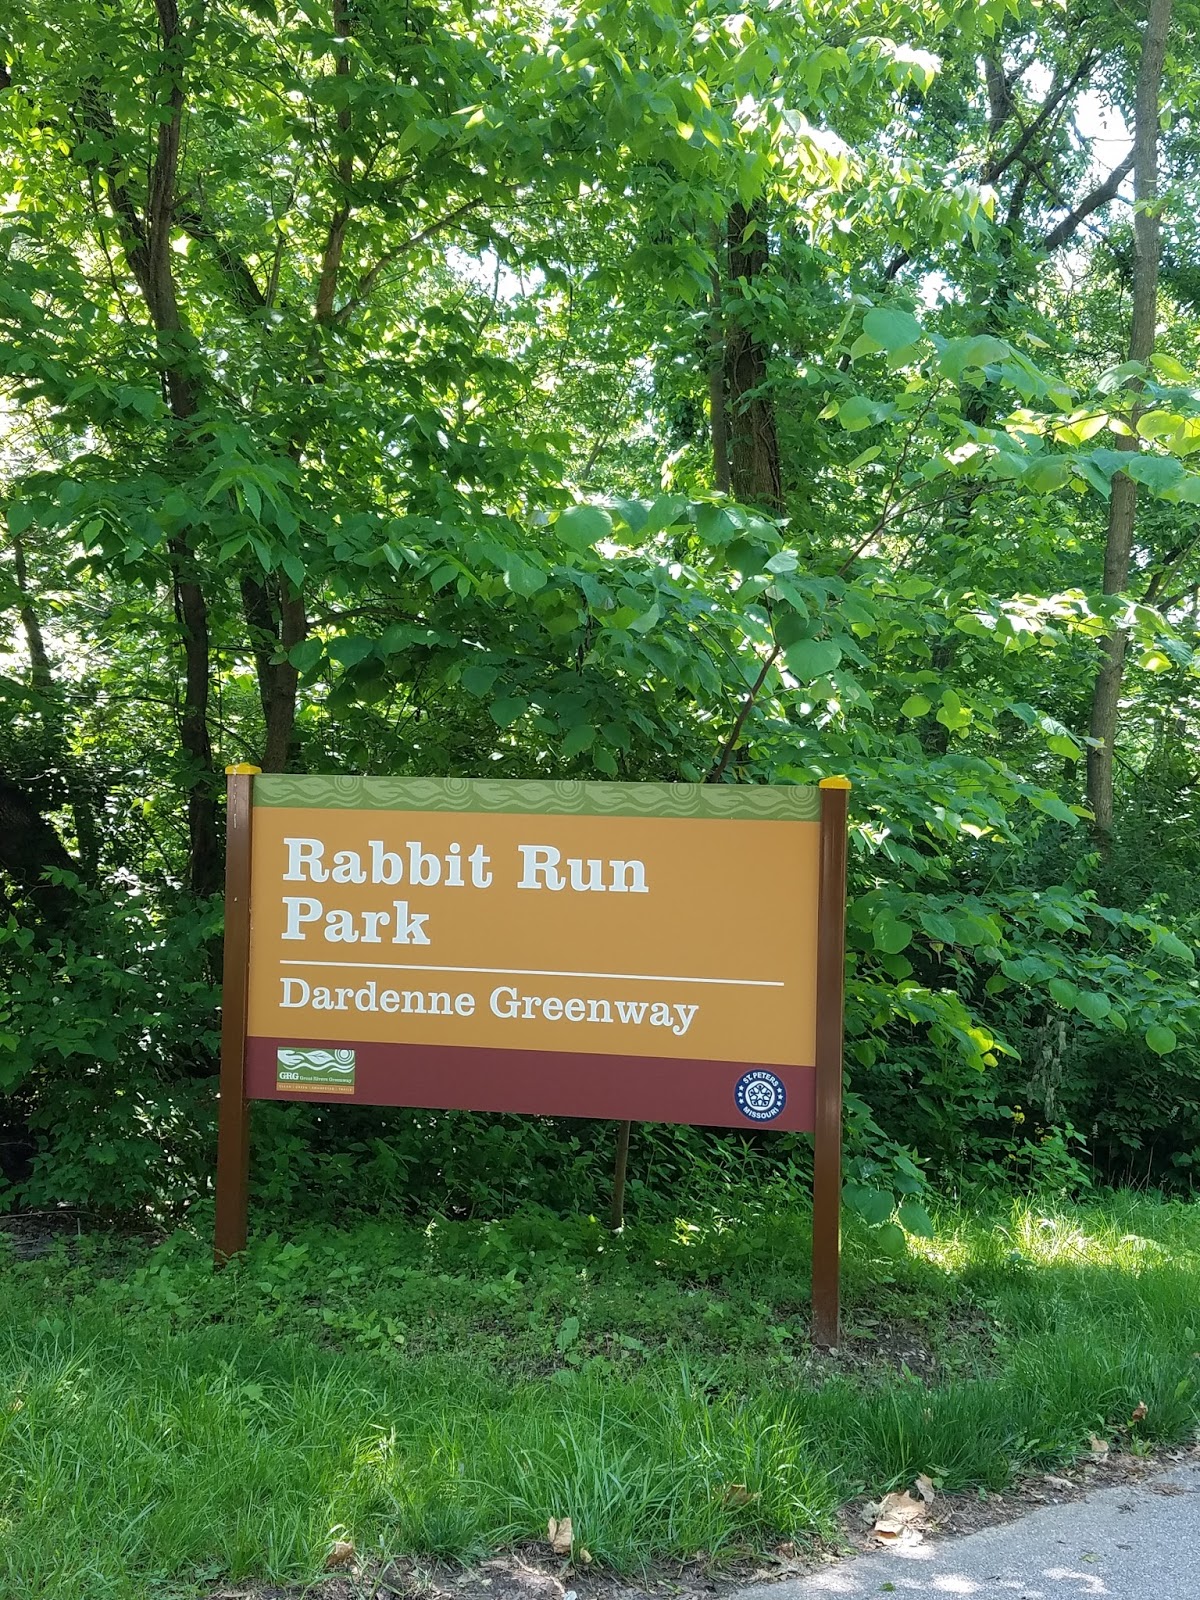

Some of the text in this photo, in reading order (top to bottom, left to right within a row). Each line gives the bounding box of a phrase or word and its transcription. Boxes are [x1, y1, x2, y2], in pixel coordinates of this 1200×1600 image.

[282, 837, 649, 893] Rabbit Run
[281, 896, 431, 945] Park
[279, 977, 699, 1036] Dardenne Greenway
[279, 1071, 299, 1080] GRG
[752, 1071, 779, 1087] PETERS
[742, 1106, 780, 1119] MISSOURI
